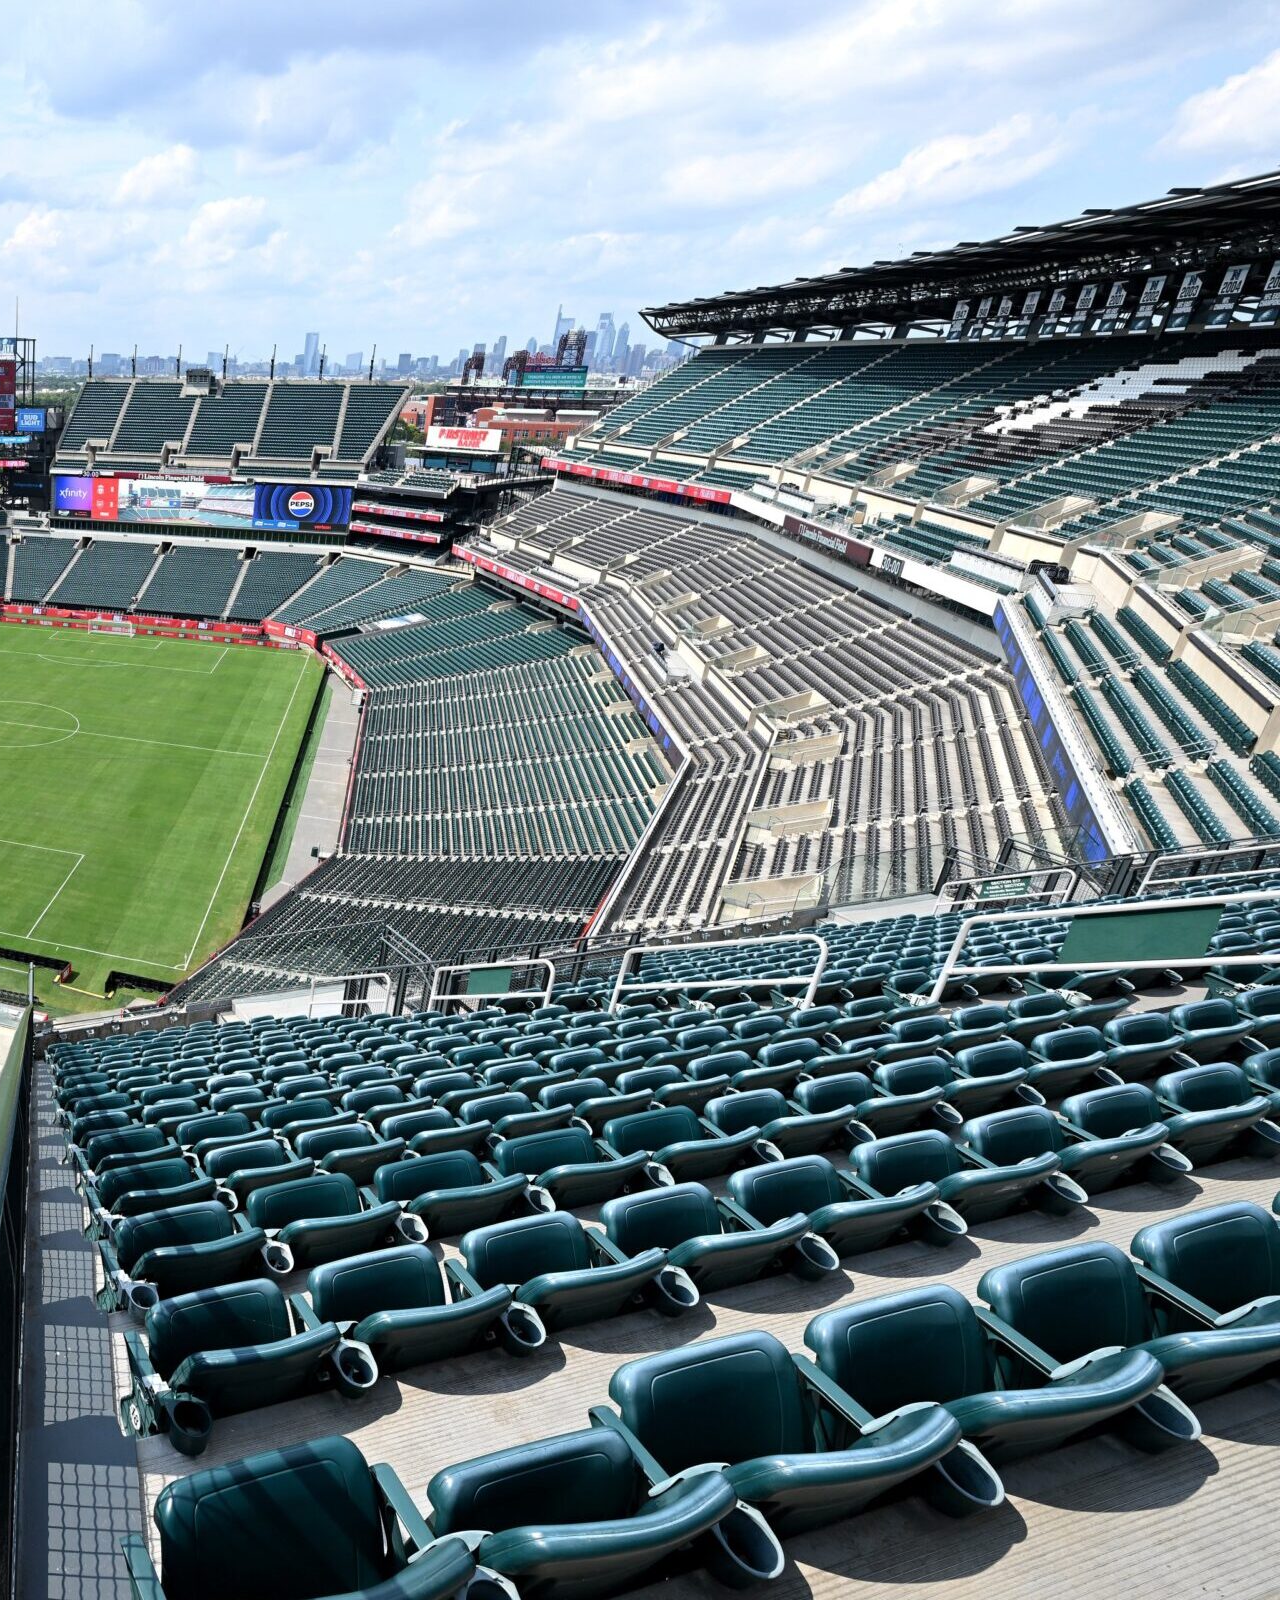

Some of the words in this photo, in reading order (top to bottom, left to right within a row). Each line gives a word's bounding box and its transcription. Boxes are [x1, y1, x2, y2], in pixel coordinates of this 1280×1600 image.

[1180, 286, 1199, 297] 2003
[1221, 281, 1241, 293] 2004
[1144, 291, 1160, 302] 2002
[457, 439, 480, 448] BANK
[59, 488, 88, 499] xfinity
[803, 527, 816, 540] Lincoln
[816, 530, 836, 549] Financial
[835, 538, 847, 553] Field
[881, 556, 900, 575] 30:00
